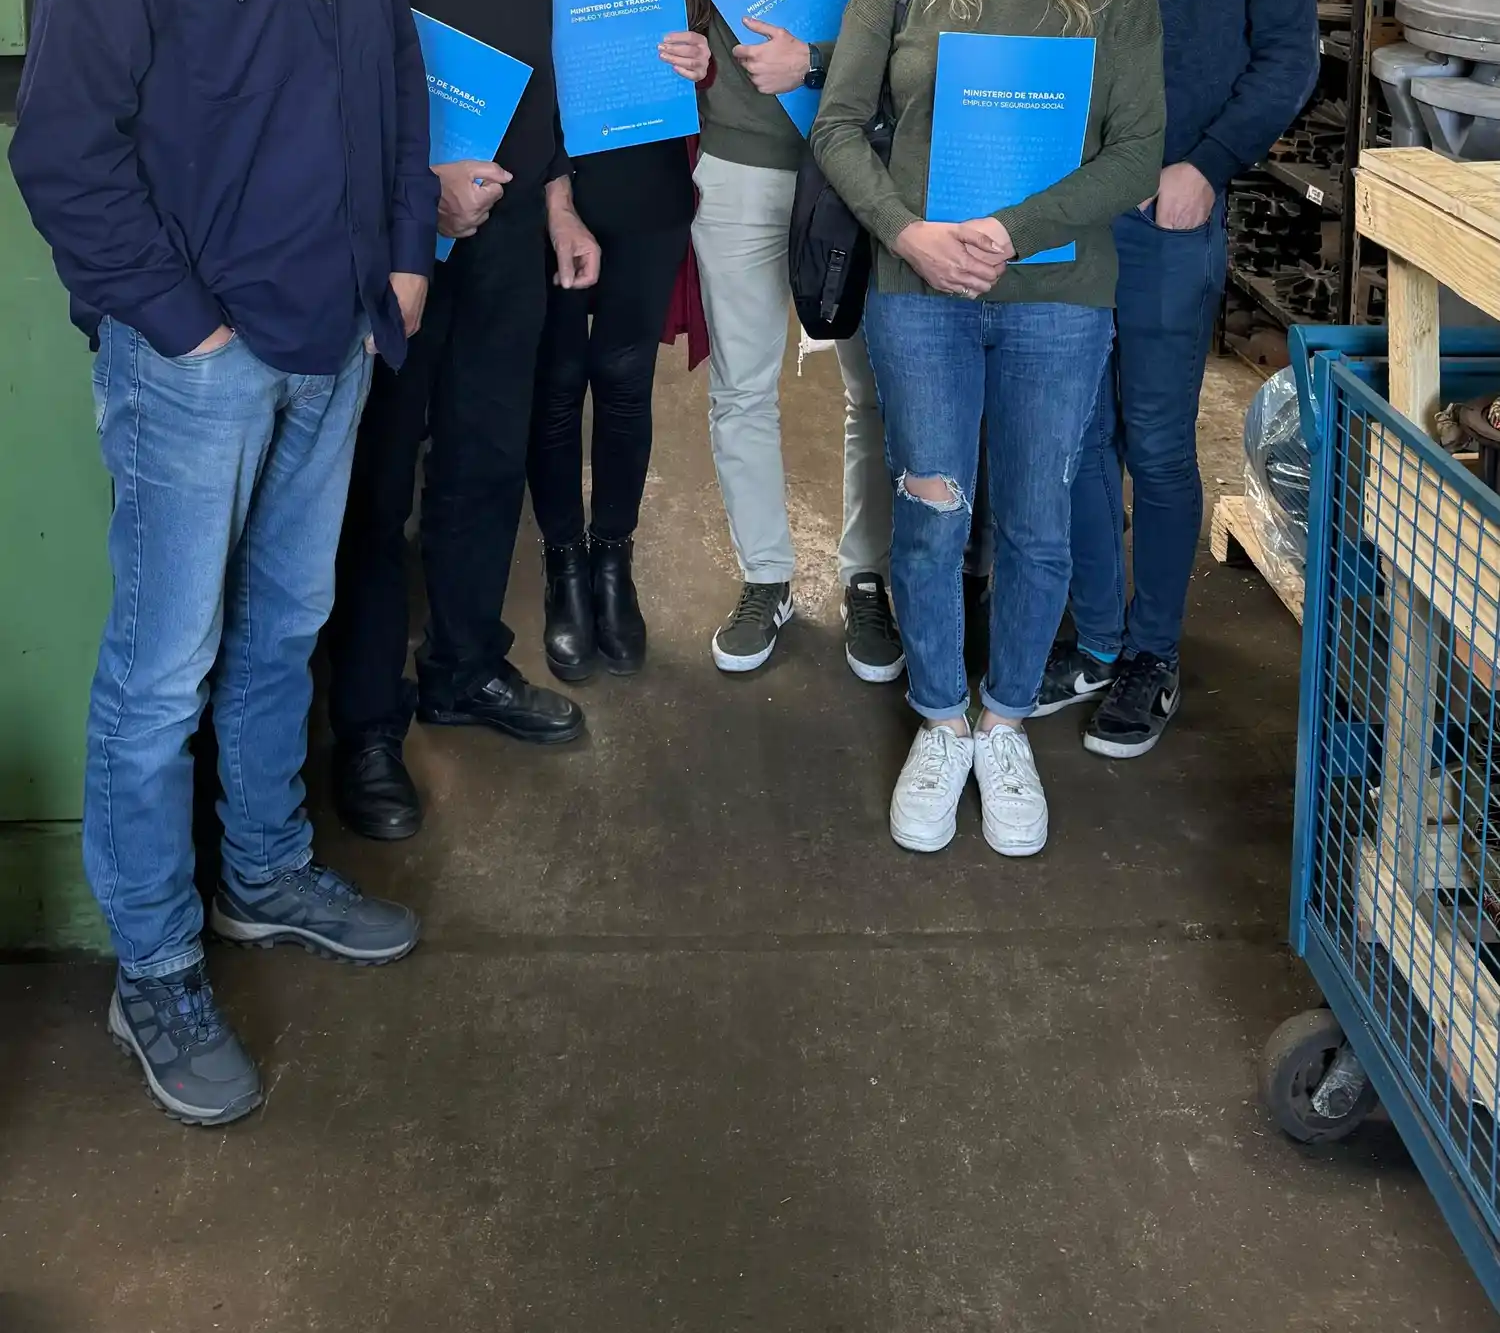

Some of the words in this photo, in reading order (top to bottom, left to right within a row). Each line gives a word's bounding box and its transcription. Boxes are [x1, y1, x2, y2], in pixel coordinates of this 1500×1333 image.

[570, 2, 612, 15] MINISTERIO
[613, 0, 624, 8] DE
[571, 13, 597, 24] EMPLEO
[602, 7, 639, 18] SEGURIDAD
[639, 3, 662, 13] SOCIAL
[751, 2, 774, 20] EMPLEO
[436, 79, 449, 90] DE
[428, 86, 459, 105] GURIDAD
[458, 100, 483, 117] SOCIAL
[963, 88, 1013, 99] MINISTERIO
[1014, 91, 1026, 100] DE
[962, 98, 993, 108] EMPLEO
[1000, 101, 1040, 110] SEGURIDAD
[1040, 102, 1065, 110] SOCIAL
